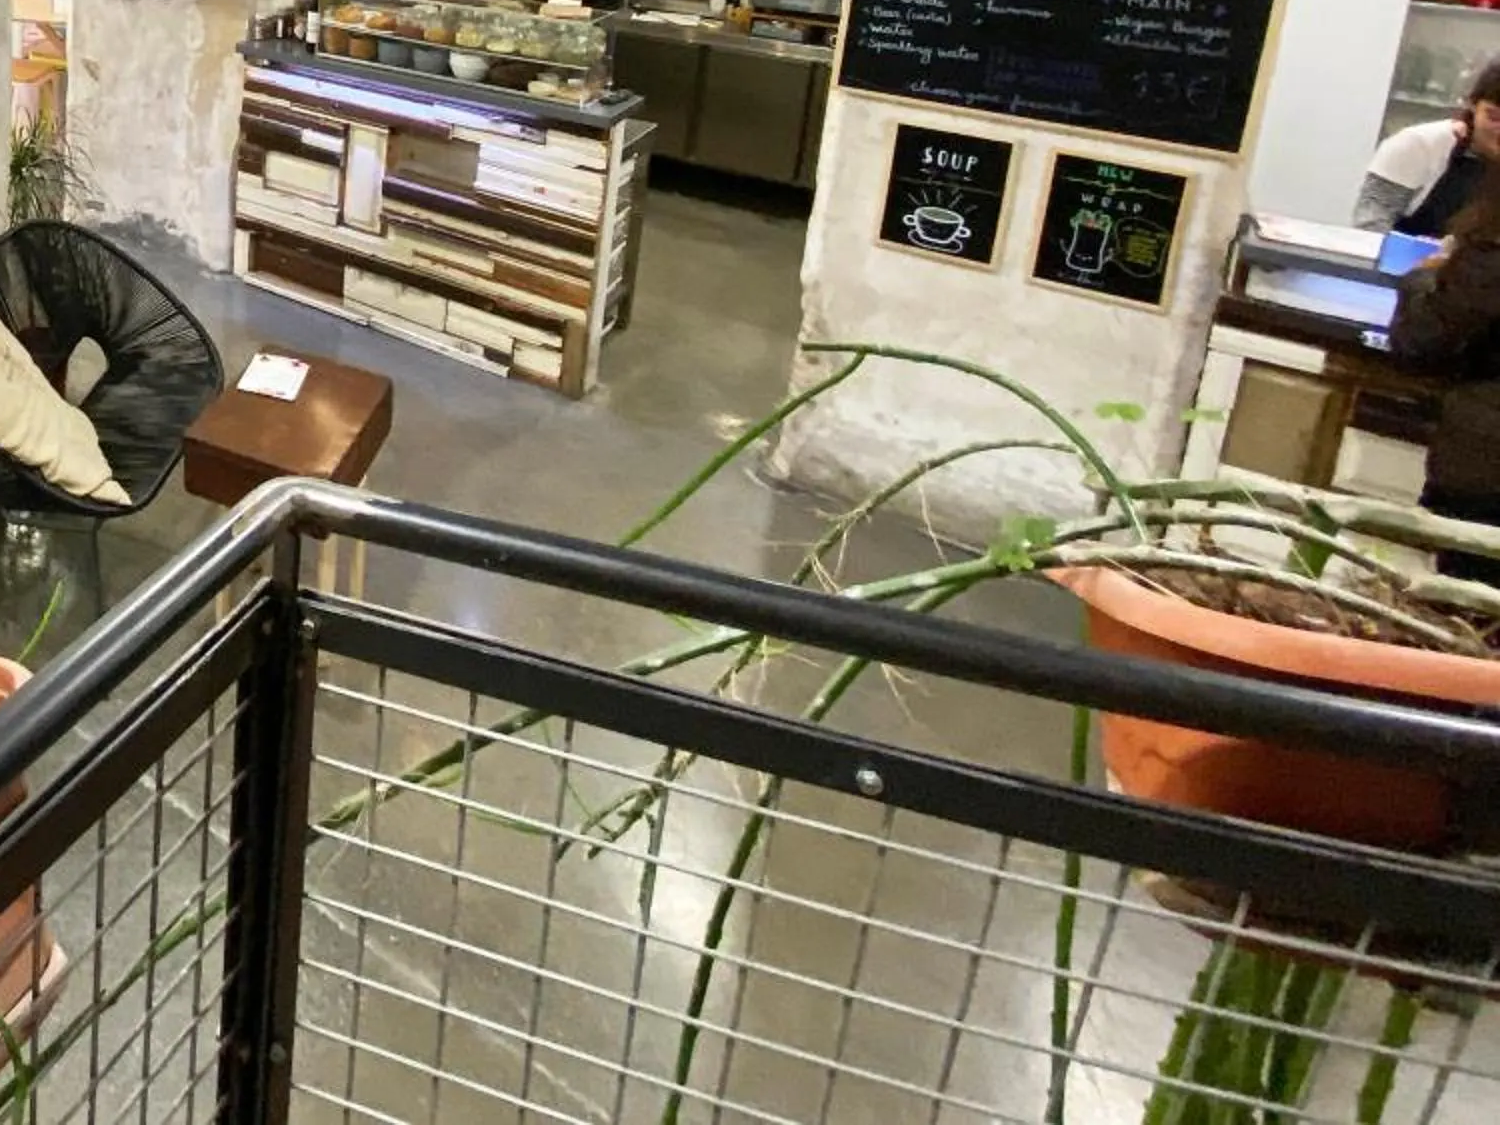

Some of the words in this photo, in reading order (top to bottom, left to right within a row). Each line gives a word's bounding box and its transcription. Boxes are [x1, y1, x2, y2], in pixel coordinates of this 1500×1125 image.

[921, 146, 980, 172] SOUP
[1097, 165, 1134, 182] NEW
[1081, 192, 1143, 214] WRAP
